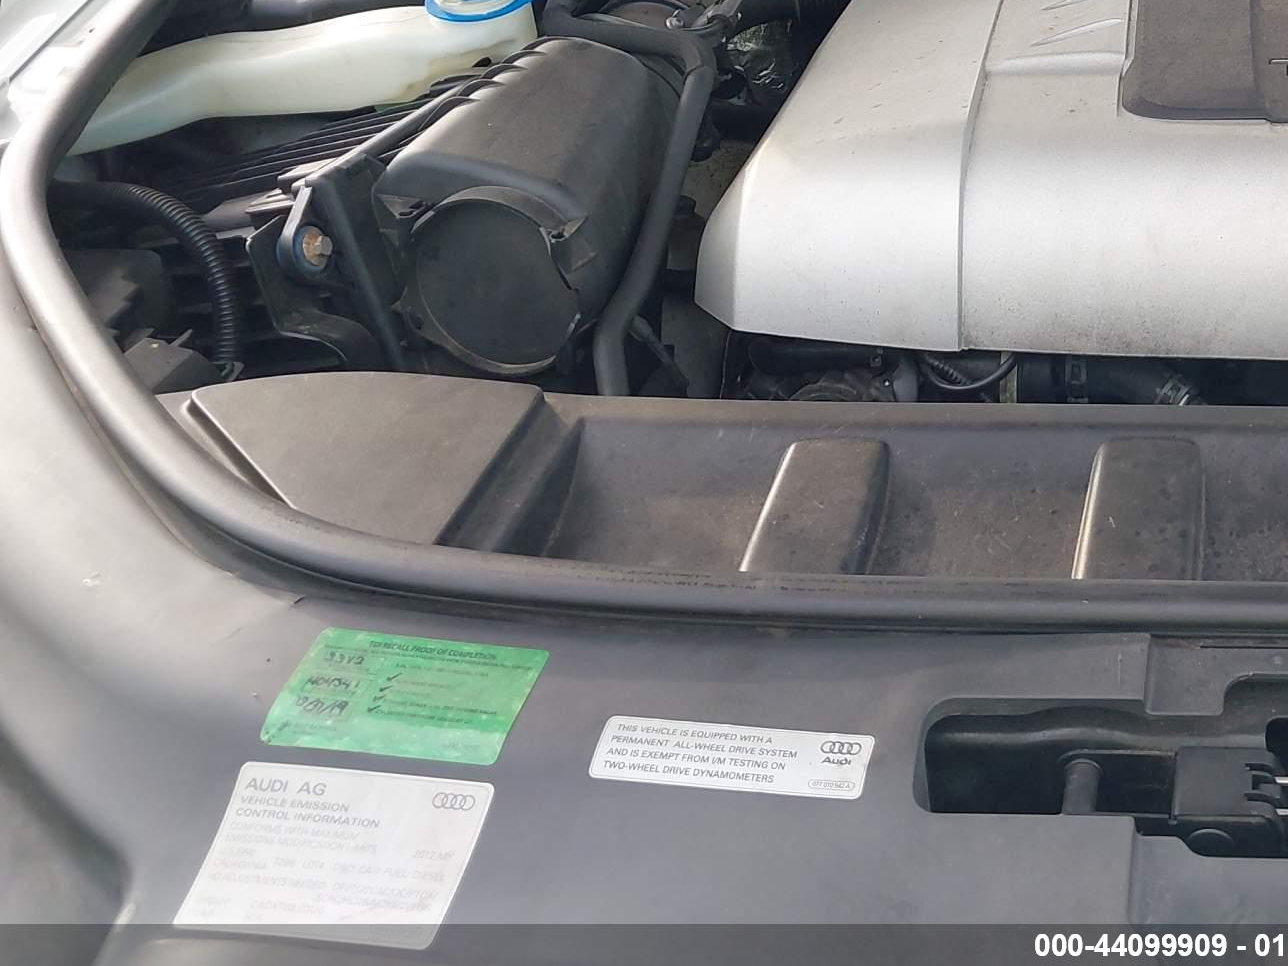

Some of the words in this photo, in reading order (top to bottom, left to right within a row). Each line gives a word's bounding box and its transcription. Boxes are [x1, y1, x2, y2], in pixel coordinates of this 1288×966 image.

[382, 642, 410, 650] RECALL
[410, 645, 435, 653] PROOF
[447, 649, 497, 660] COMPLETION
[617, 724, 637, 732] THIS
[639, 726, 677, 735] VEHICLE
[690, 730, 737, 740] EQUIPPED
[739, 734, 764, 743] WITH
[765, 736, 772, 744] A
[610, 735, 669, 746] PERMANENT
[673, 741, 726, 752] ALL-WHEEL
[728, 745, 756, 754] DRIVE
[758, 748, 797, 758] SYSTEM
[606, 747, 628, 755] AND
[640, 750, 679, 761] EXEMPT
[681, 754, 709, 763] FROM
[711, 756, 726, 765] I/M
[728, 758, 768, 768] TESTING
[770, 762, 785, 770] ON
[820, 756, 852, 766] Audi
[602, 760, 661, 772] TWO-WHEEL
[662, 765, 690, 775] DRIVE
[692, 768, 774, 783] DYNAMOMETERS
[245, 776, 290, 792] AUDI
[297, 781, 327, 795] AG
[239, 794, 287, 807] VEHICLE
[289, 799, 350, 812] EMISSION
[234, 807, 290, 820] CONTROL
[293, 812, 380, 828] INFORMATION
